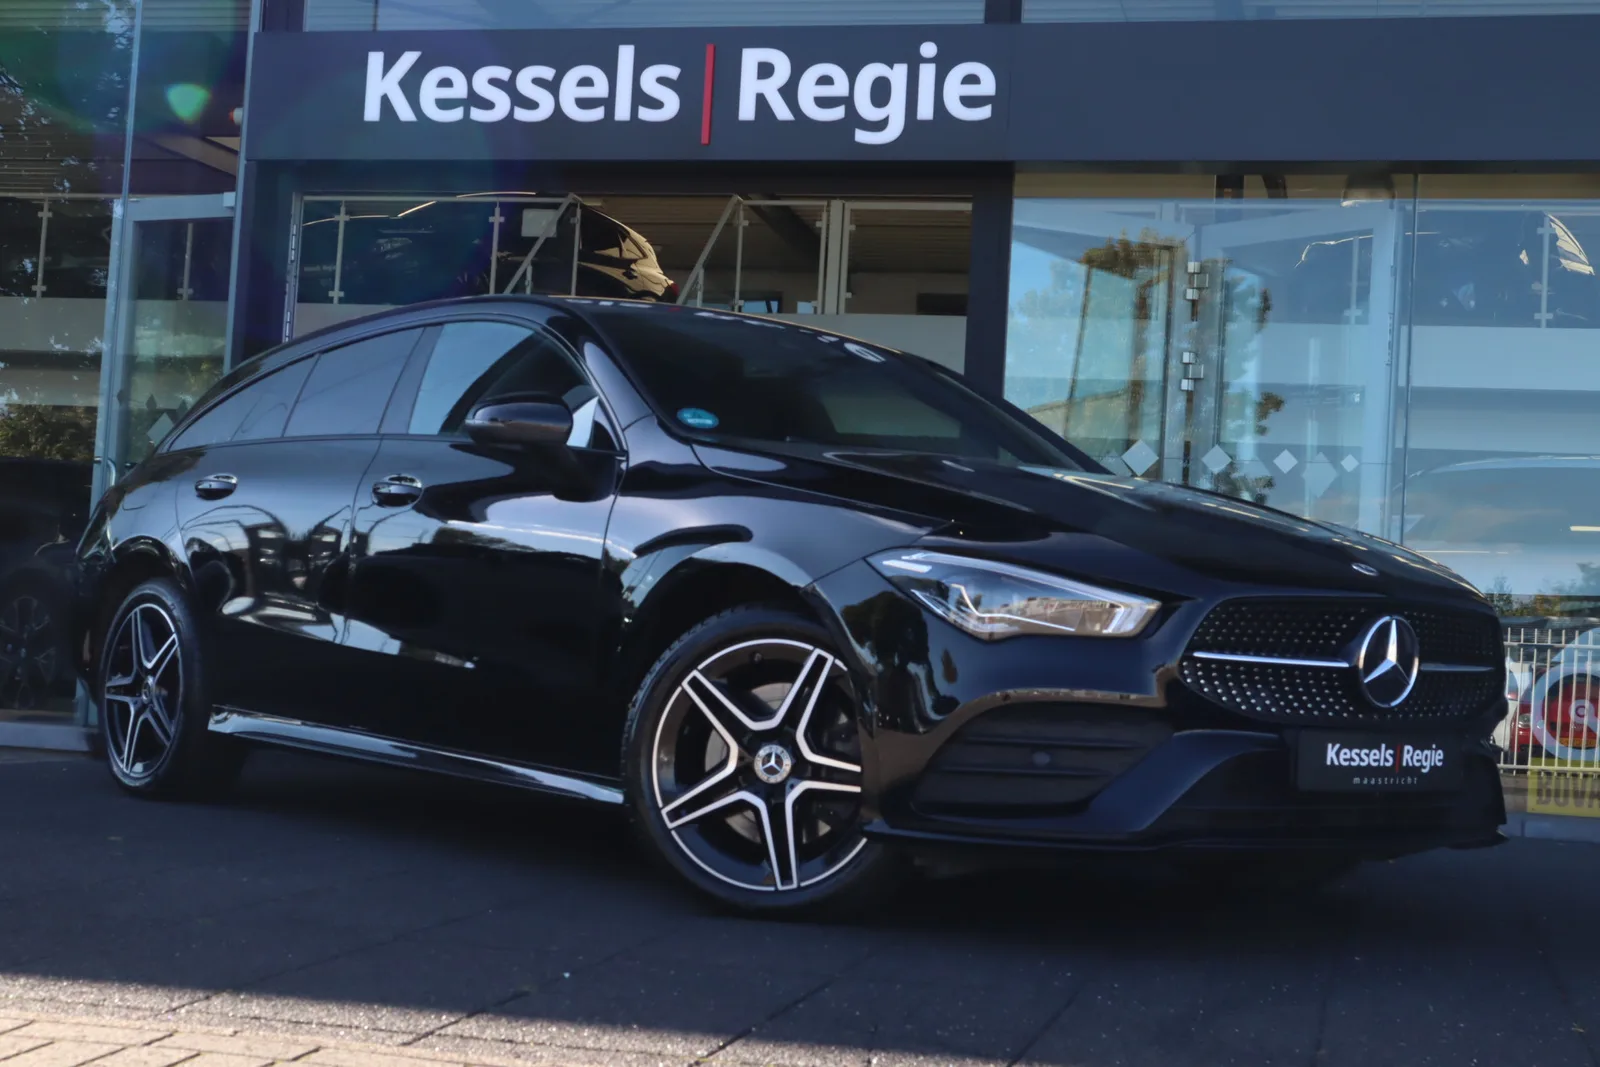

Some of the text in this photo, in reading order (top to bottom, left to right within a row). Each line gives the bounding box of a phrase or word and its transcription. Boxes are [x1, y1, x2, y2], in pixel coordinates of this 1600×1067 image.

[363, 41, 997, 145] Kessels Regie
[1326, 743, 1444, 773] Kessels Regie
[1353, 776, 1417, 785] maastricht
